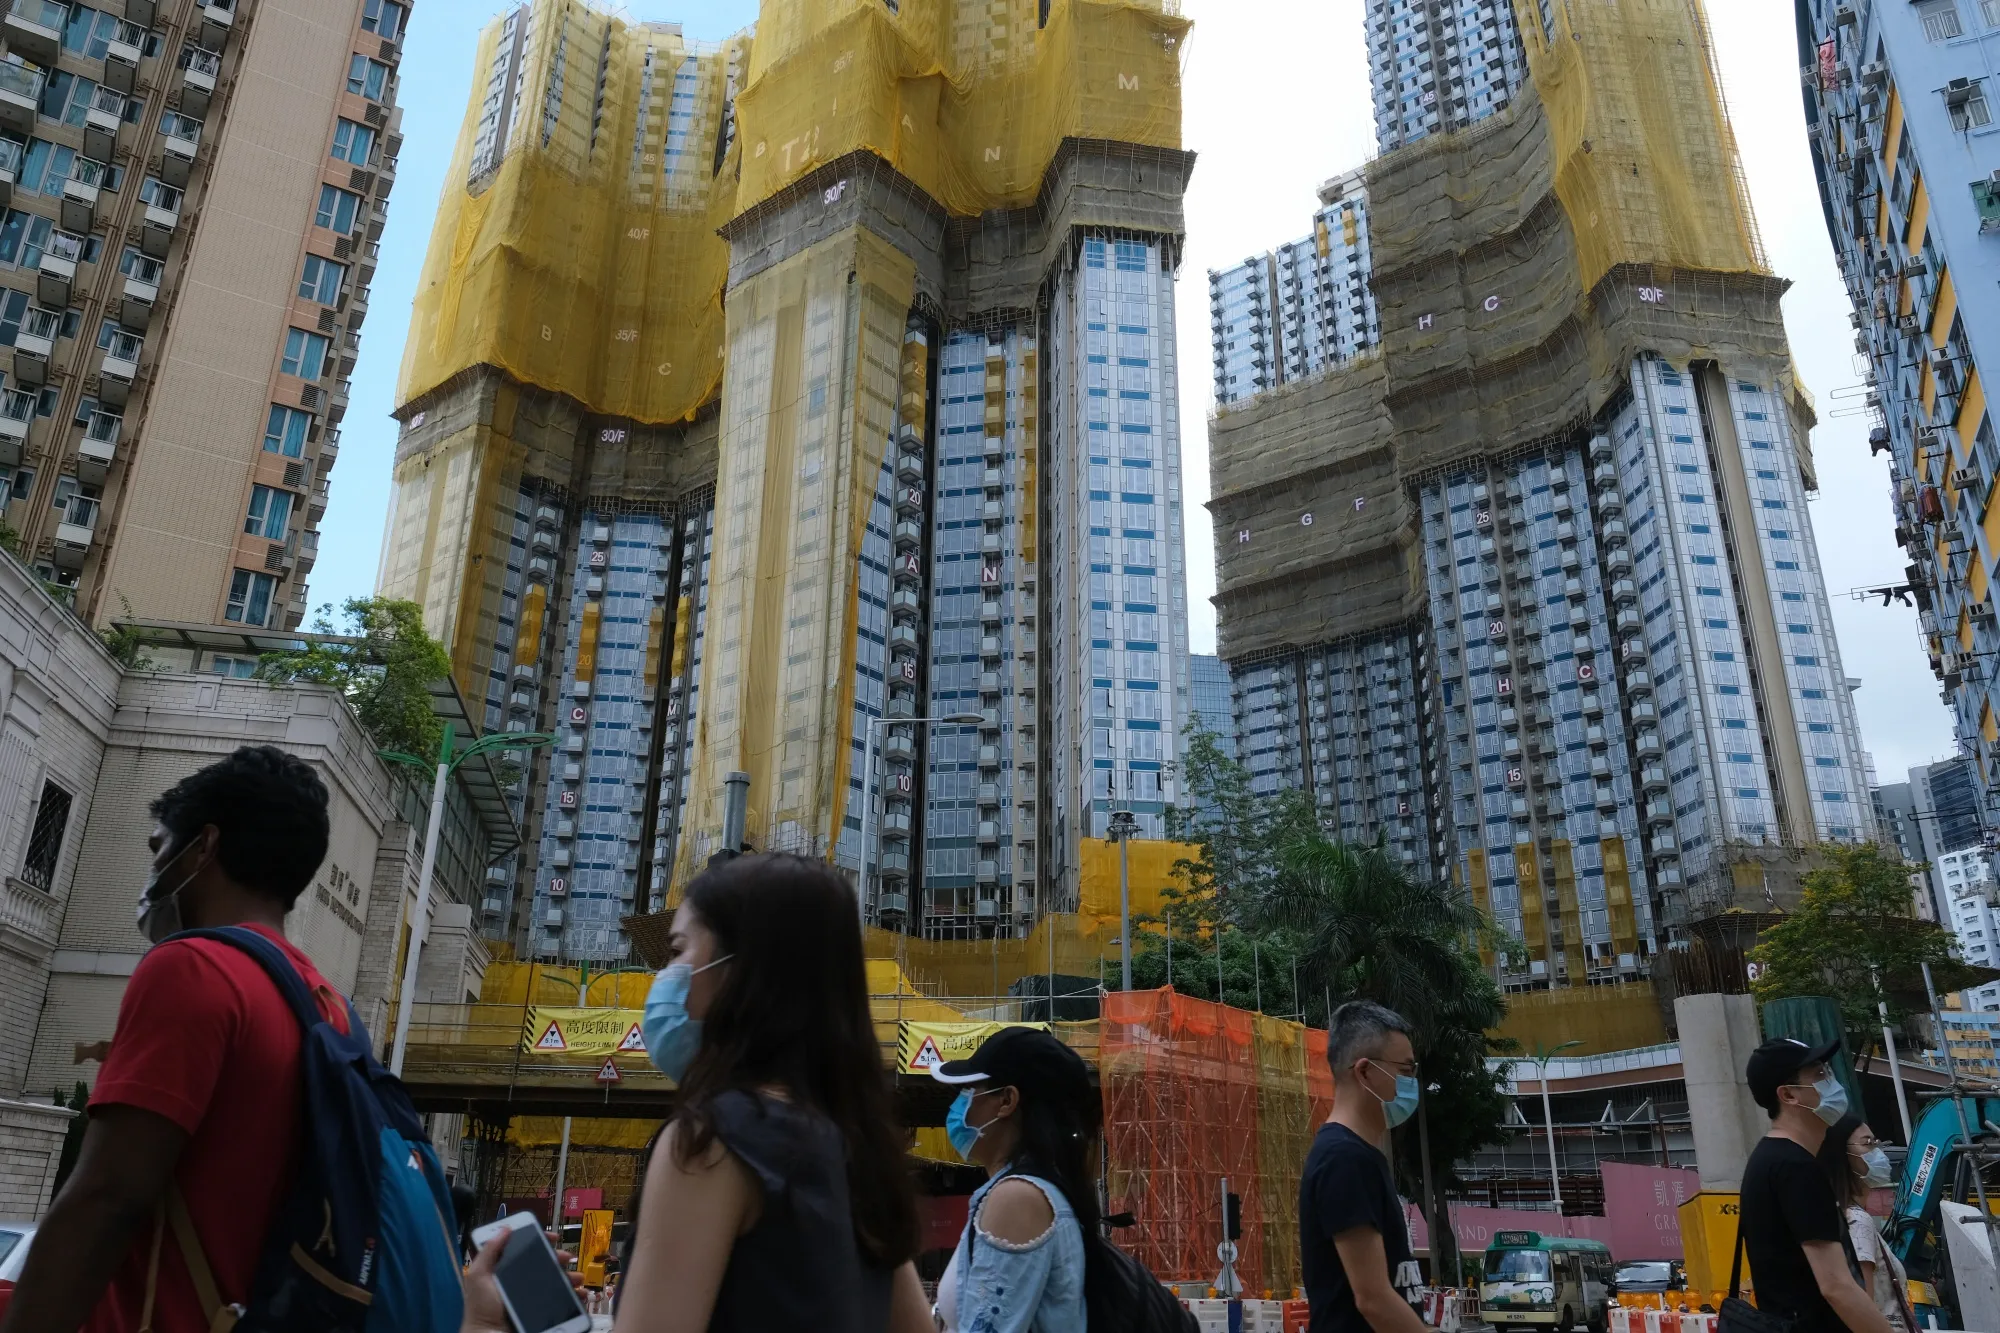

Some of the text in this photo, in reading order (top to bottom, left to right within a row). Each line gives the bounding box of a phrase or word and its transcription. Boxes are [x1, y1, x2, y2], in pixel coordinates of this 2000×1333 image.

[833, 50, 855, 74] 35/F
[1118, 73, 1139, 90] M
[1423, 91, 1434, 102] 45
[755, 141, 766, 158] B
[984, 145, 1001, 163] N
[644, 153, 655, 162] 45
[824, 180, 846, 204] 30/F
[627, 228, 650, 241] 40/F
[1638, 287, 1664, 303] 30/F
[1484, 295, 1498, 311] C
[1418, 313, 1432, 331] H
[541, 324, 552, 341] B
[615, 328, 638, 342] 35/F
[657, 362, 672, 376] C
[914, 361, 925, 378] 25
[601, 429, 625, 443] 30/F
[909, 488, 921, 505] 20
[1355, 497, 1364, 511] F
[1301, 513, 1313, 525] G
[1476, 511, 1489, 524] 25
[1239, 529, 1249, 543] H
[591, 551, 604, 562] 25
[907, 556, 918, 573] A
[983, 566, 997, 581] N
[1490, 621, 1503, 634] 20
[1622, 642, 1629, 657] B
[578, 654, 592, 666] 20
[903, 662, 914, 679] 15
[1579, 665, 1591, 678] C
[1498, 678, 1510, 692] H
[572, 707, 583, 720] C
[667, 703, 677, 717] M
[1508, 768, 1521, 782] 15
[899, 774, 910, 792] 10
[562, 791, 574, 803] 15
[1433, 792, 1438, 803] E
[1399, 802, 1406, 813] F
[1519, 862, 1532, 876] 10
[551, 878, 564, 891] 10
[566, 1020, 624, 1035] 高度限制
[1654, 1214, 1679, 1230] GRA
[1457, 1225, 1487, 1241] AND
